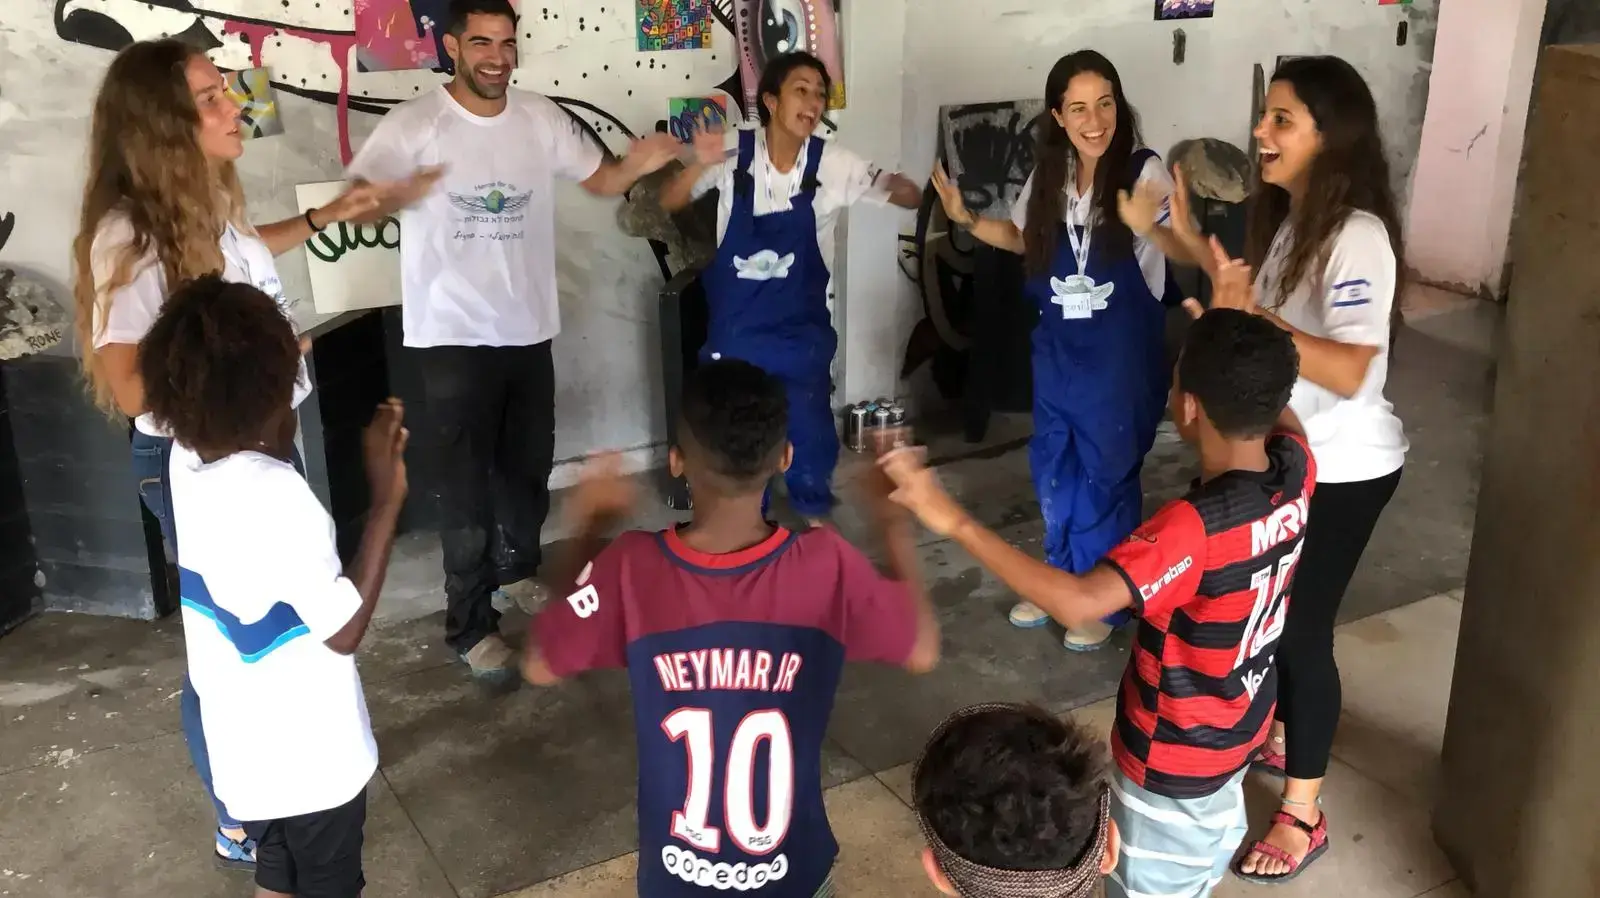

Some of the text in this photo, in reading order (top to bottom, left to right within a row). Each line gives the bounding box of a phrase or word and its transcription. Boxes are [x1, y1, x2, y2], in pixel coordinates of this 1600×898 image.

[26, 329, 61, 349] RONE
[1139, 555, 1193, 602] Carabao
[653, 648, 803, 692] NEYMAR JR
[660, 706, 795, 856] 10
[748, 834, 773, 847] PSG
[665, 852, 782, 884] ooredoo
